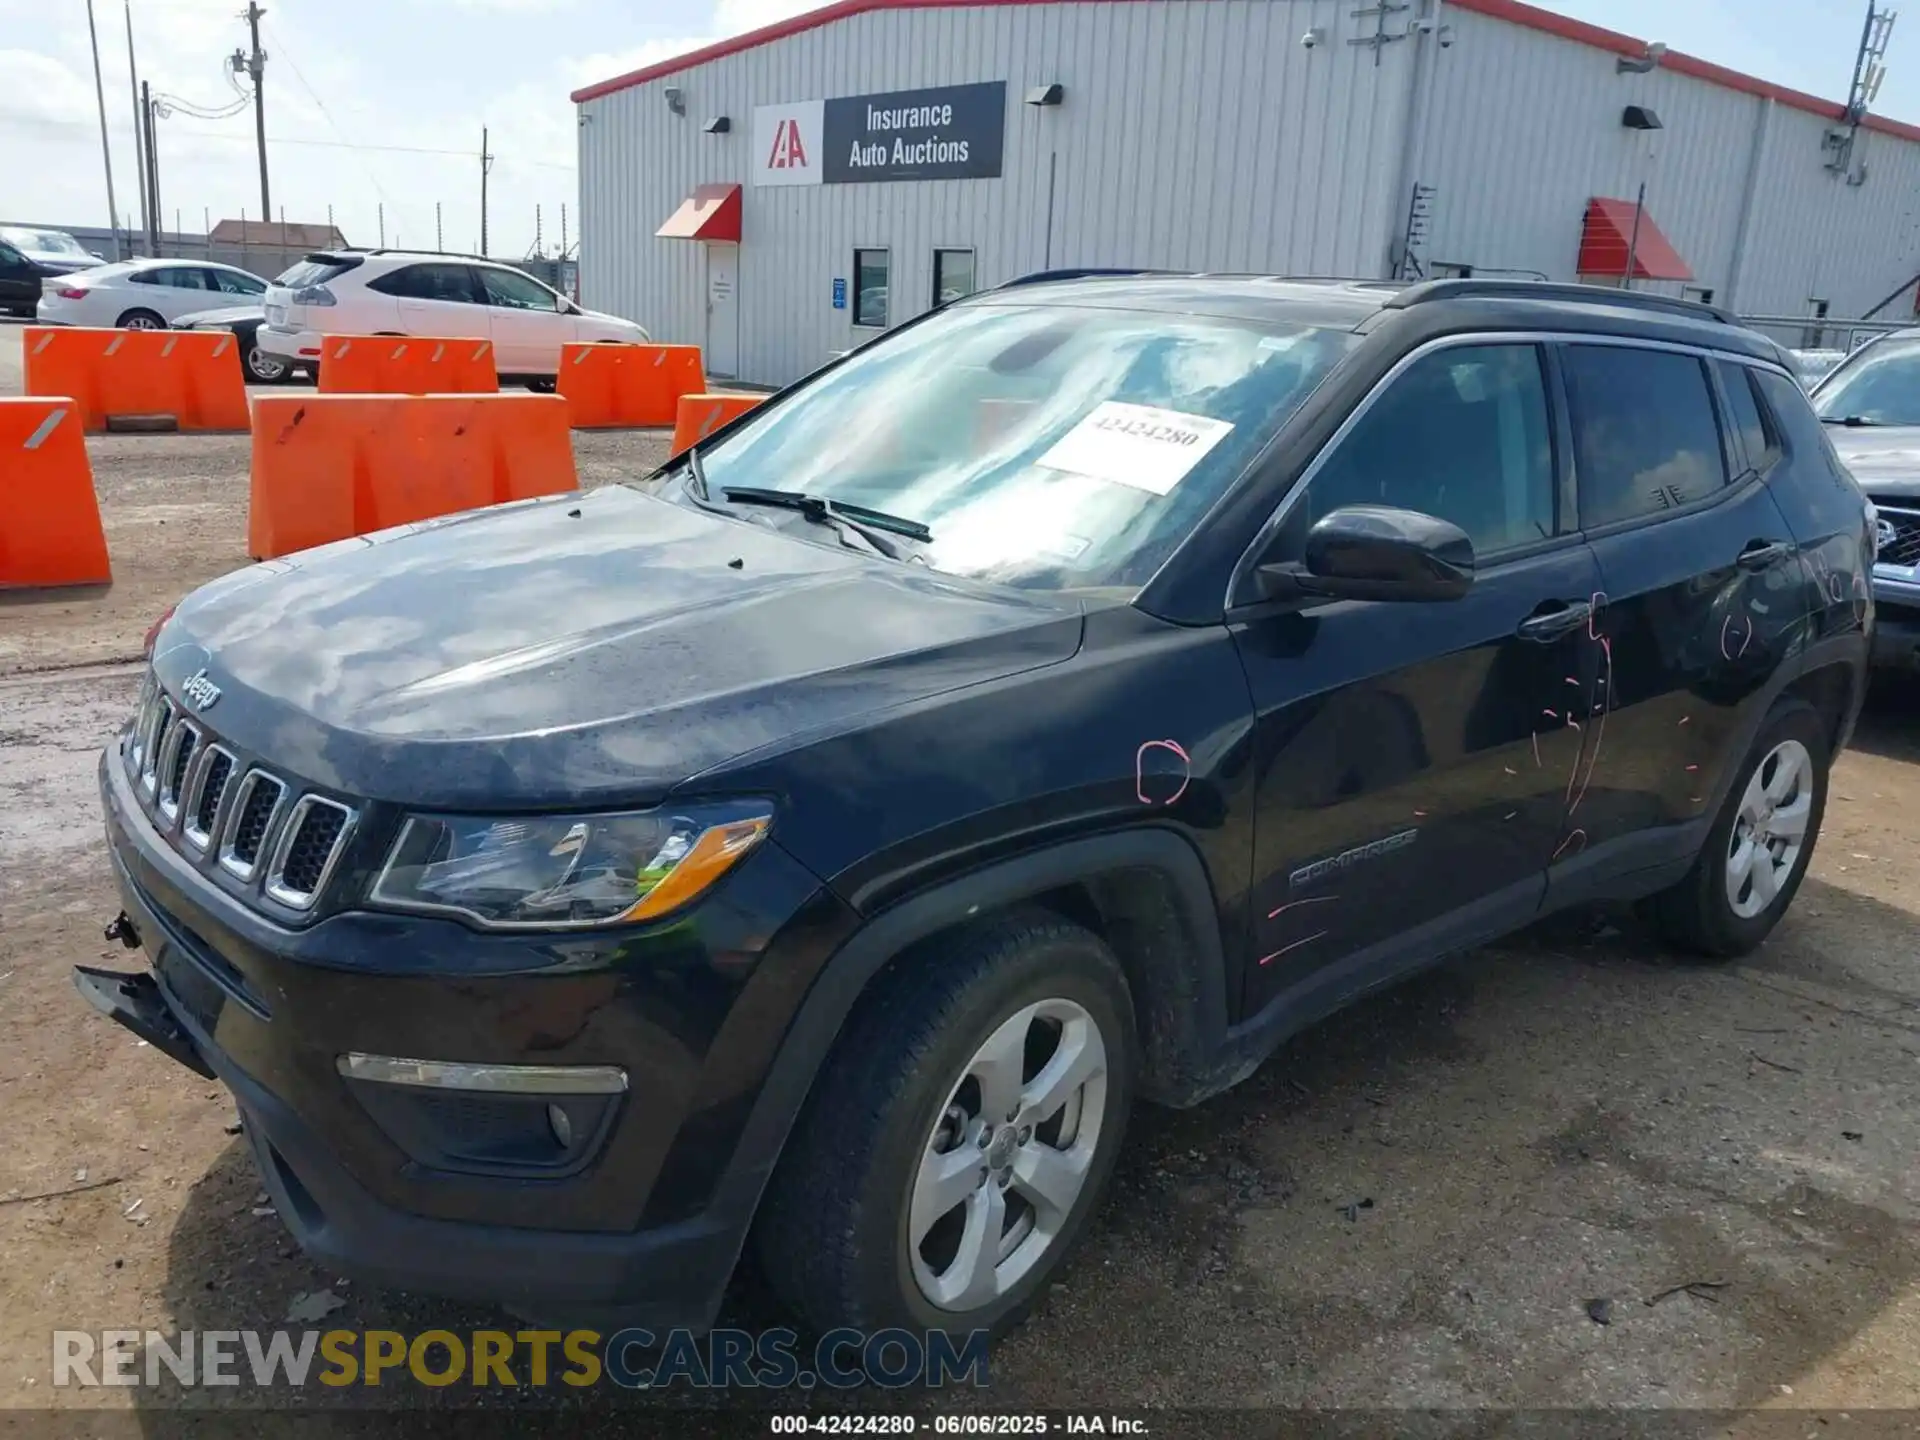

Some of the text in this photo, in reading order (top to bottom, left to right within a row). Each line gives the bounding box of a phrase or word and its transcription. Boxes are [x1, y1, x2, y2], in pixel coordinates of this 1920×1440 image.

[866, 104, 952, 132] Insurance
[849, 136, 969, 168] Auto Auctions
[1095, 415, 1199, 446] 42424280
[182, 667, 222, 711] Jeep
